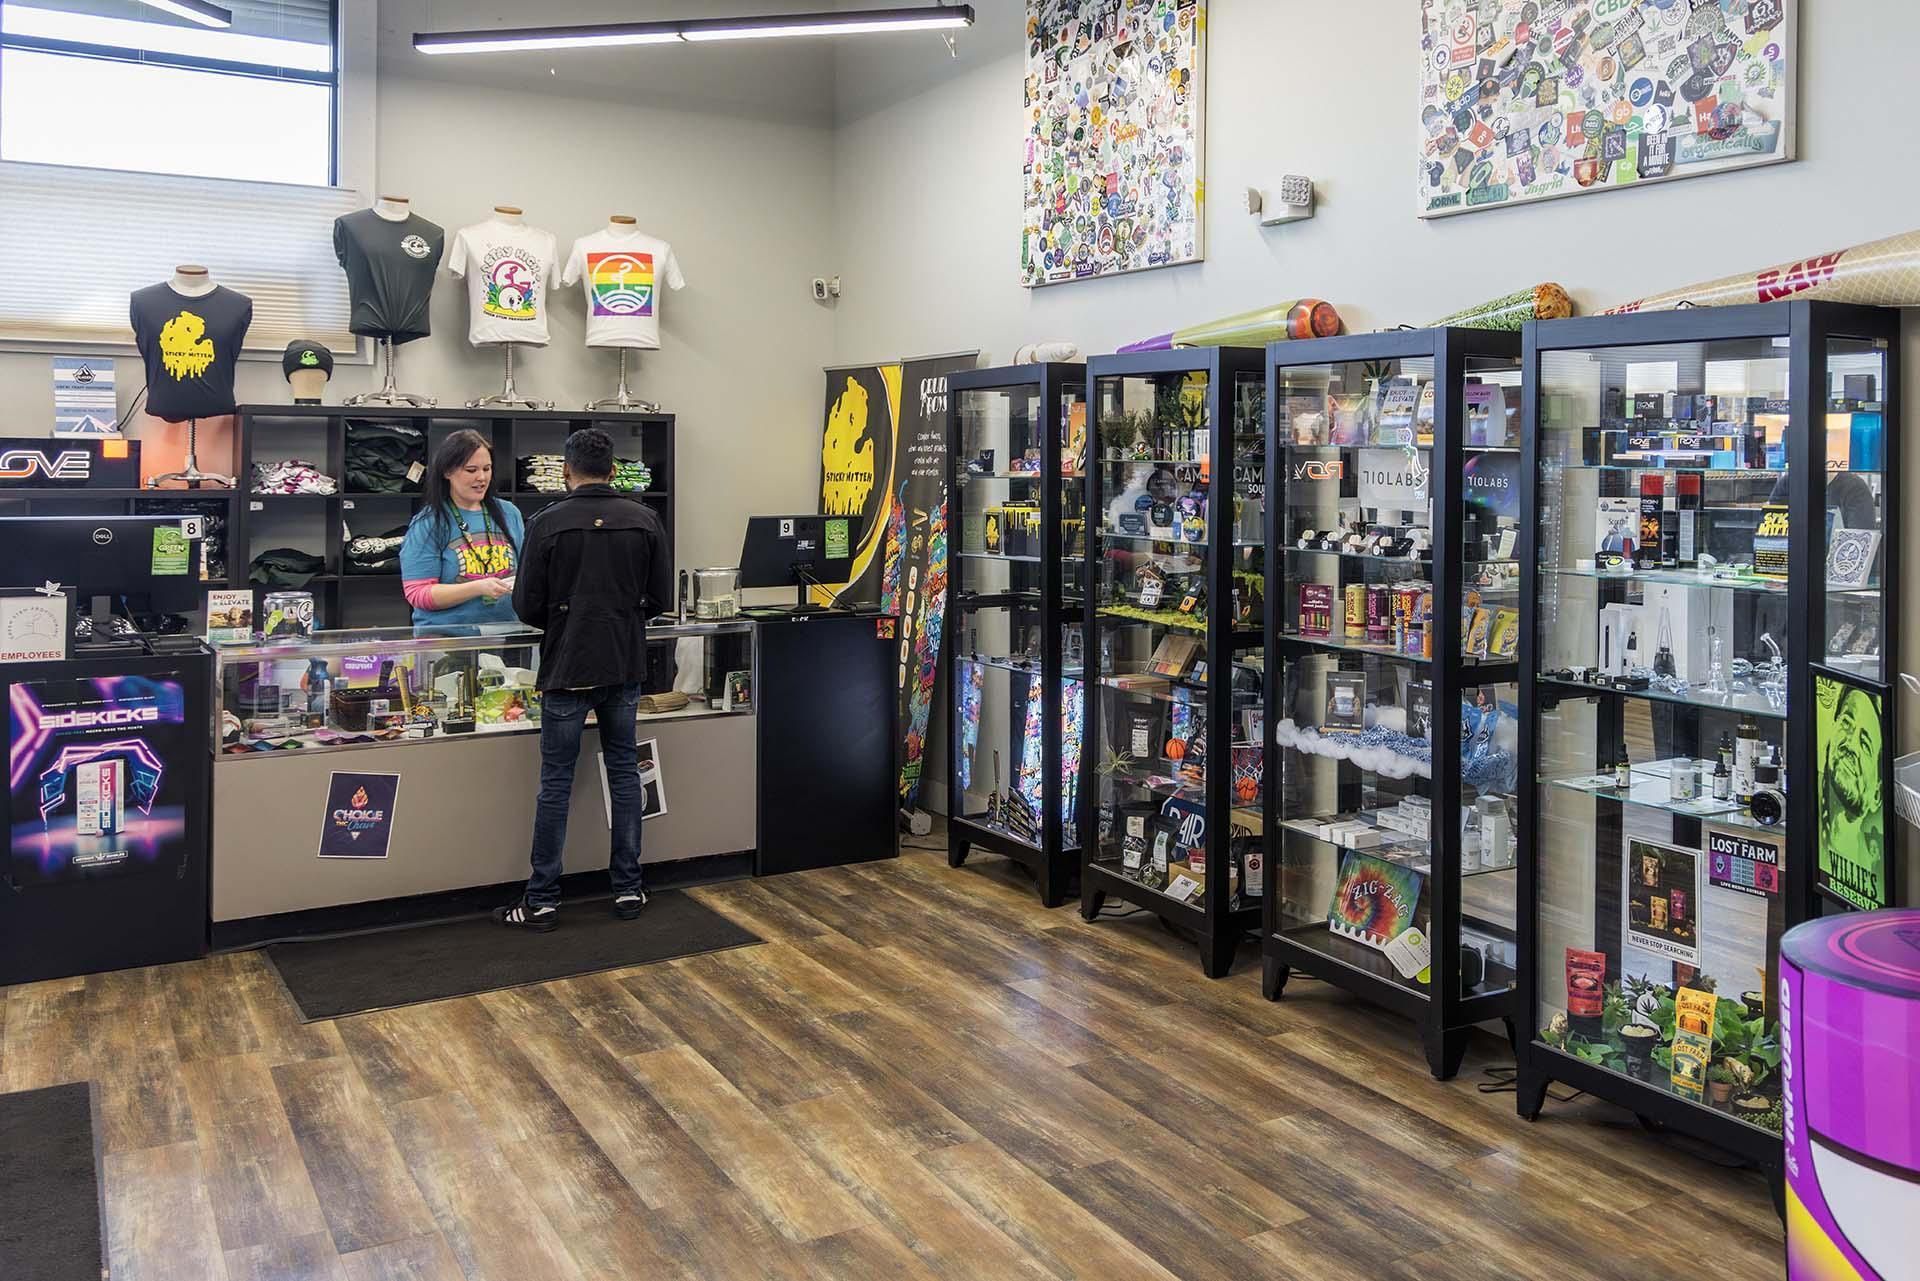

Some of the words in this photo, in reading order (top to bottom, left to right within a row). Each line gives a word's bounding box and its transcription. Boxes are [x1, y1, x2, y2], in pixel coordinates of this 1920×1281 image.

[1756, 250, 1848, 303] RAW
[826, 472, 845, 482] STICKY
[846, 471, 873, 483] MITTEN
[187, 522, 196, 535] 8
[783, 522, 791, 533] 9
[1, 651, 62, 660] EMPLOYEES
[333, 810, 384, 822] CHOICE
[1711, 836, 1740, 855] LOST
[1741, 843, 1777, 864] FARM
[1828, 849, 1878, 900] WILLIE'S
[1351, 879, 1409, 919] ZIG-ZAG
[1631, 935, 1650, 946] NEVER
[1650, 940, 1664, 949] STOP
[1664, 944, 1694, 959] SEARCHING
[1781, 977, 1795, 1145] INFUSED
